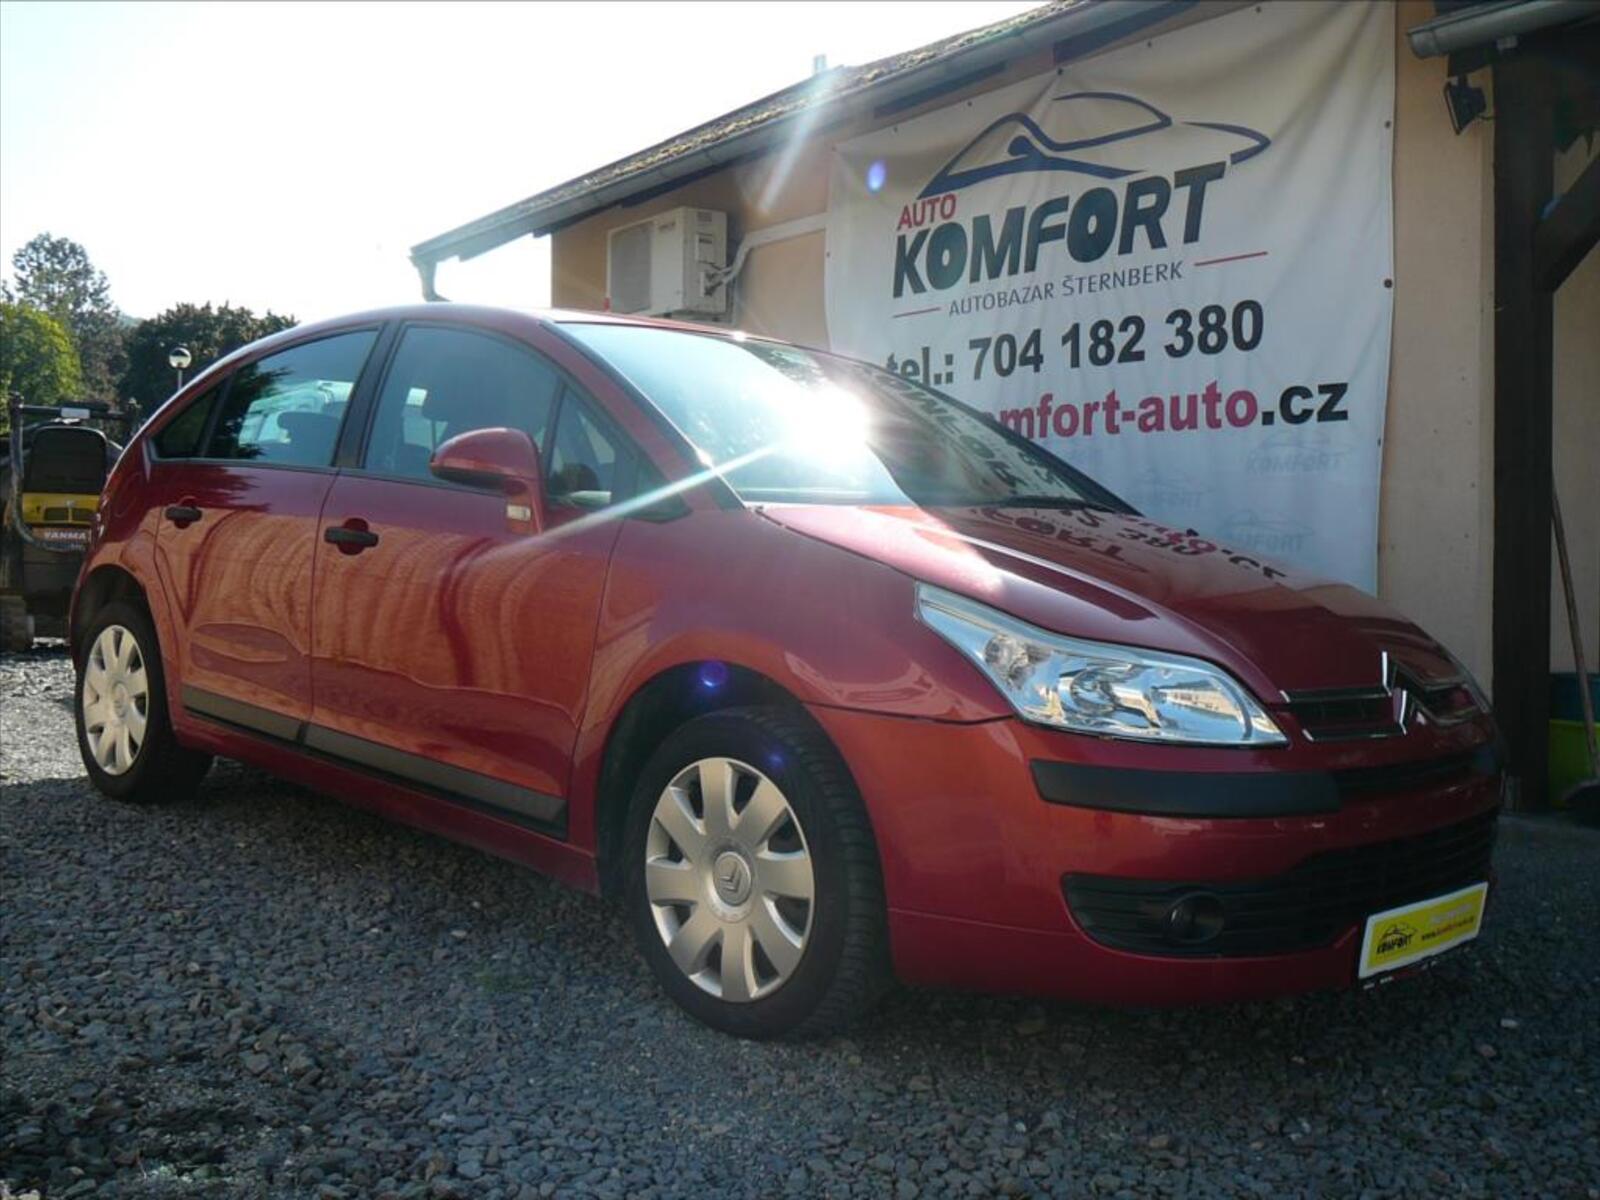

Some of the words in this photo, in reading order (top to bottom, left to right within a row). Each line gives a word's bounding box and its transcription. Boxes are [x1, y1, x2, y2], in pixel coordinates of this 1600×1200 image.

[893, 161, 1226, 298] KOMFORT
[896, 193, 956, 230] AUTO
[948, 281, 1055, 317] AUTOBAZAR
[1061, 260, 1184, 298] ŠTERNBERK
[886, 346, 955, 388] tel.:
[968, 328, 1044, 382] 704
[1061, 314, 1145, 369] 182
[1164, 299, 1265, 358] 380
[984, 381, 1349, 439] mfort-auto.cz
